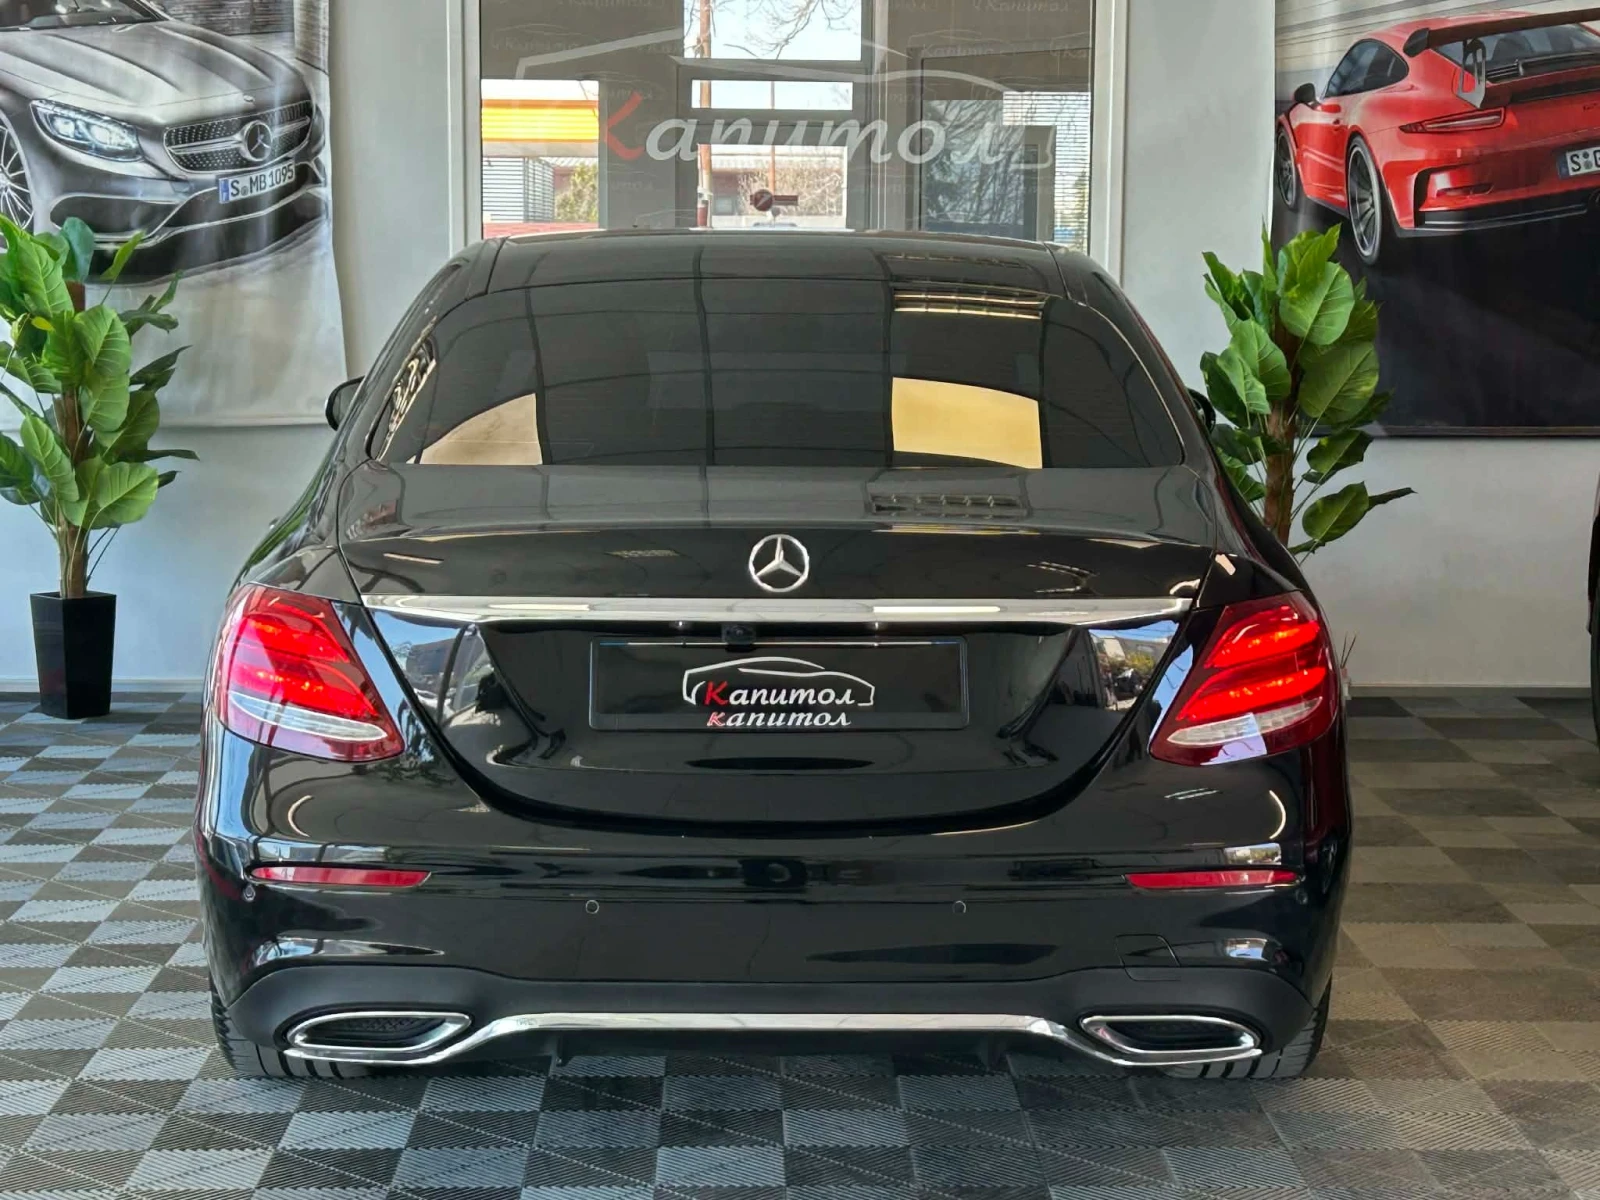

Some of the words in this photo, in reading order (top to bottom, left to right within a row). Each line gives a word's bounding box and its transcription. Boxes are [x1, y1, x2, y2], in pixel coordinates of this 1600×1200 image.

[1570, 153, 1581, 172] S
[230, 180, 240, 197] S
[249, 174, 267, 194] MB
[268, 163, 294, 188] 1095
[704, 681, 855, 706] Капитол
